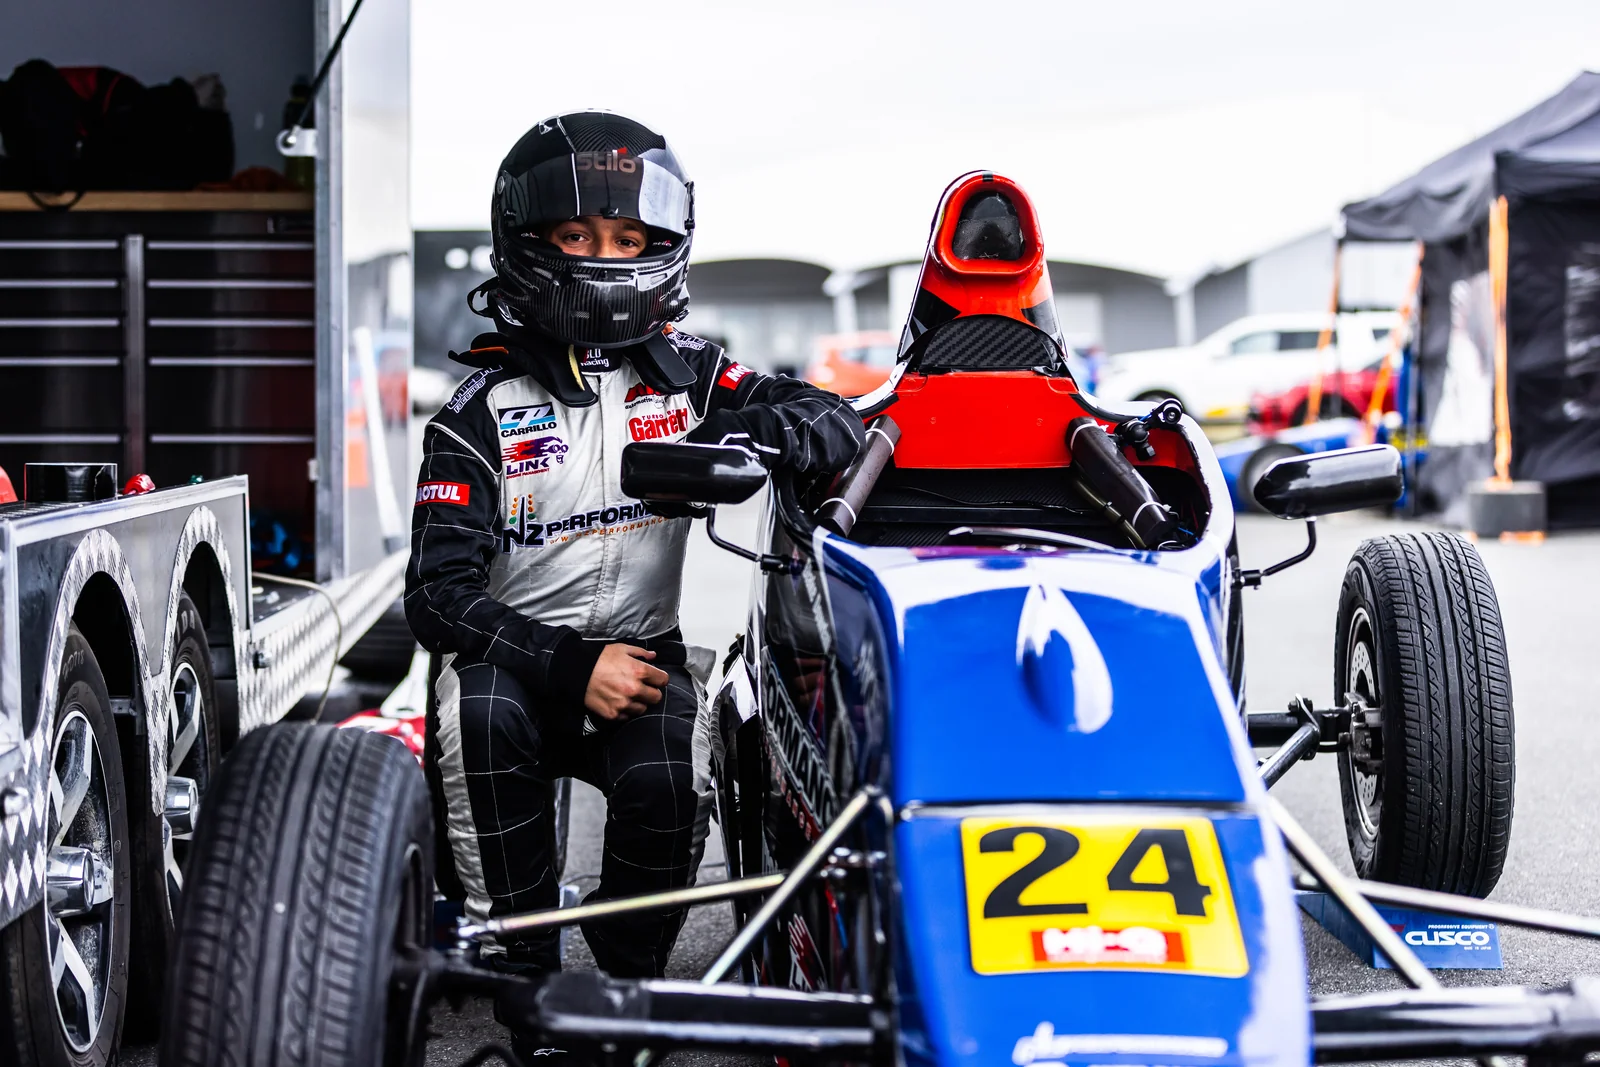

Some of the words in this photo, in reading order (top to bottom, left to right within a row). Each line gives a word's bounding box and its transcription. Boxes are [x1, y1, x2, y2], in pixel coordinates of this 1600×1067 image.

[628, 407, 688, 442] Garrett
[641, 413, 664, 421] TURBO
[501, 421, 557, 438] CARRILLO
[506, 457, 550, 475] LINK
[979, 824, 1213, 919] 24
[1405, 931, 1490, 946] CUSCO
